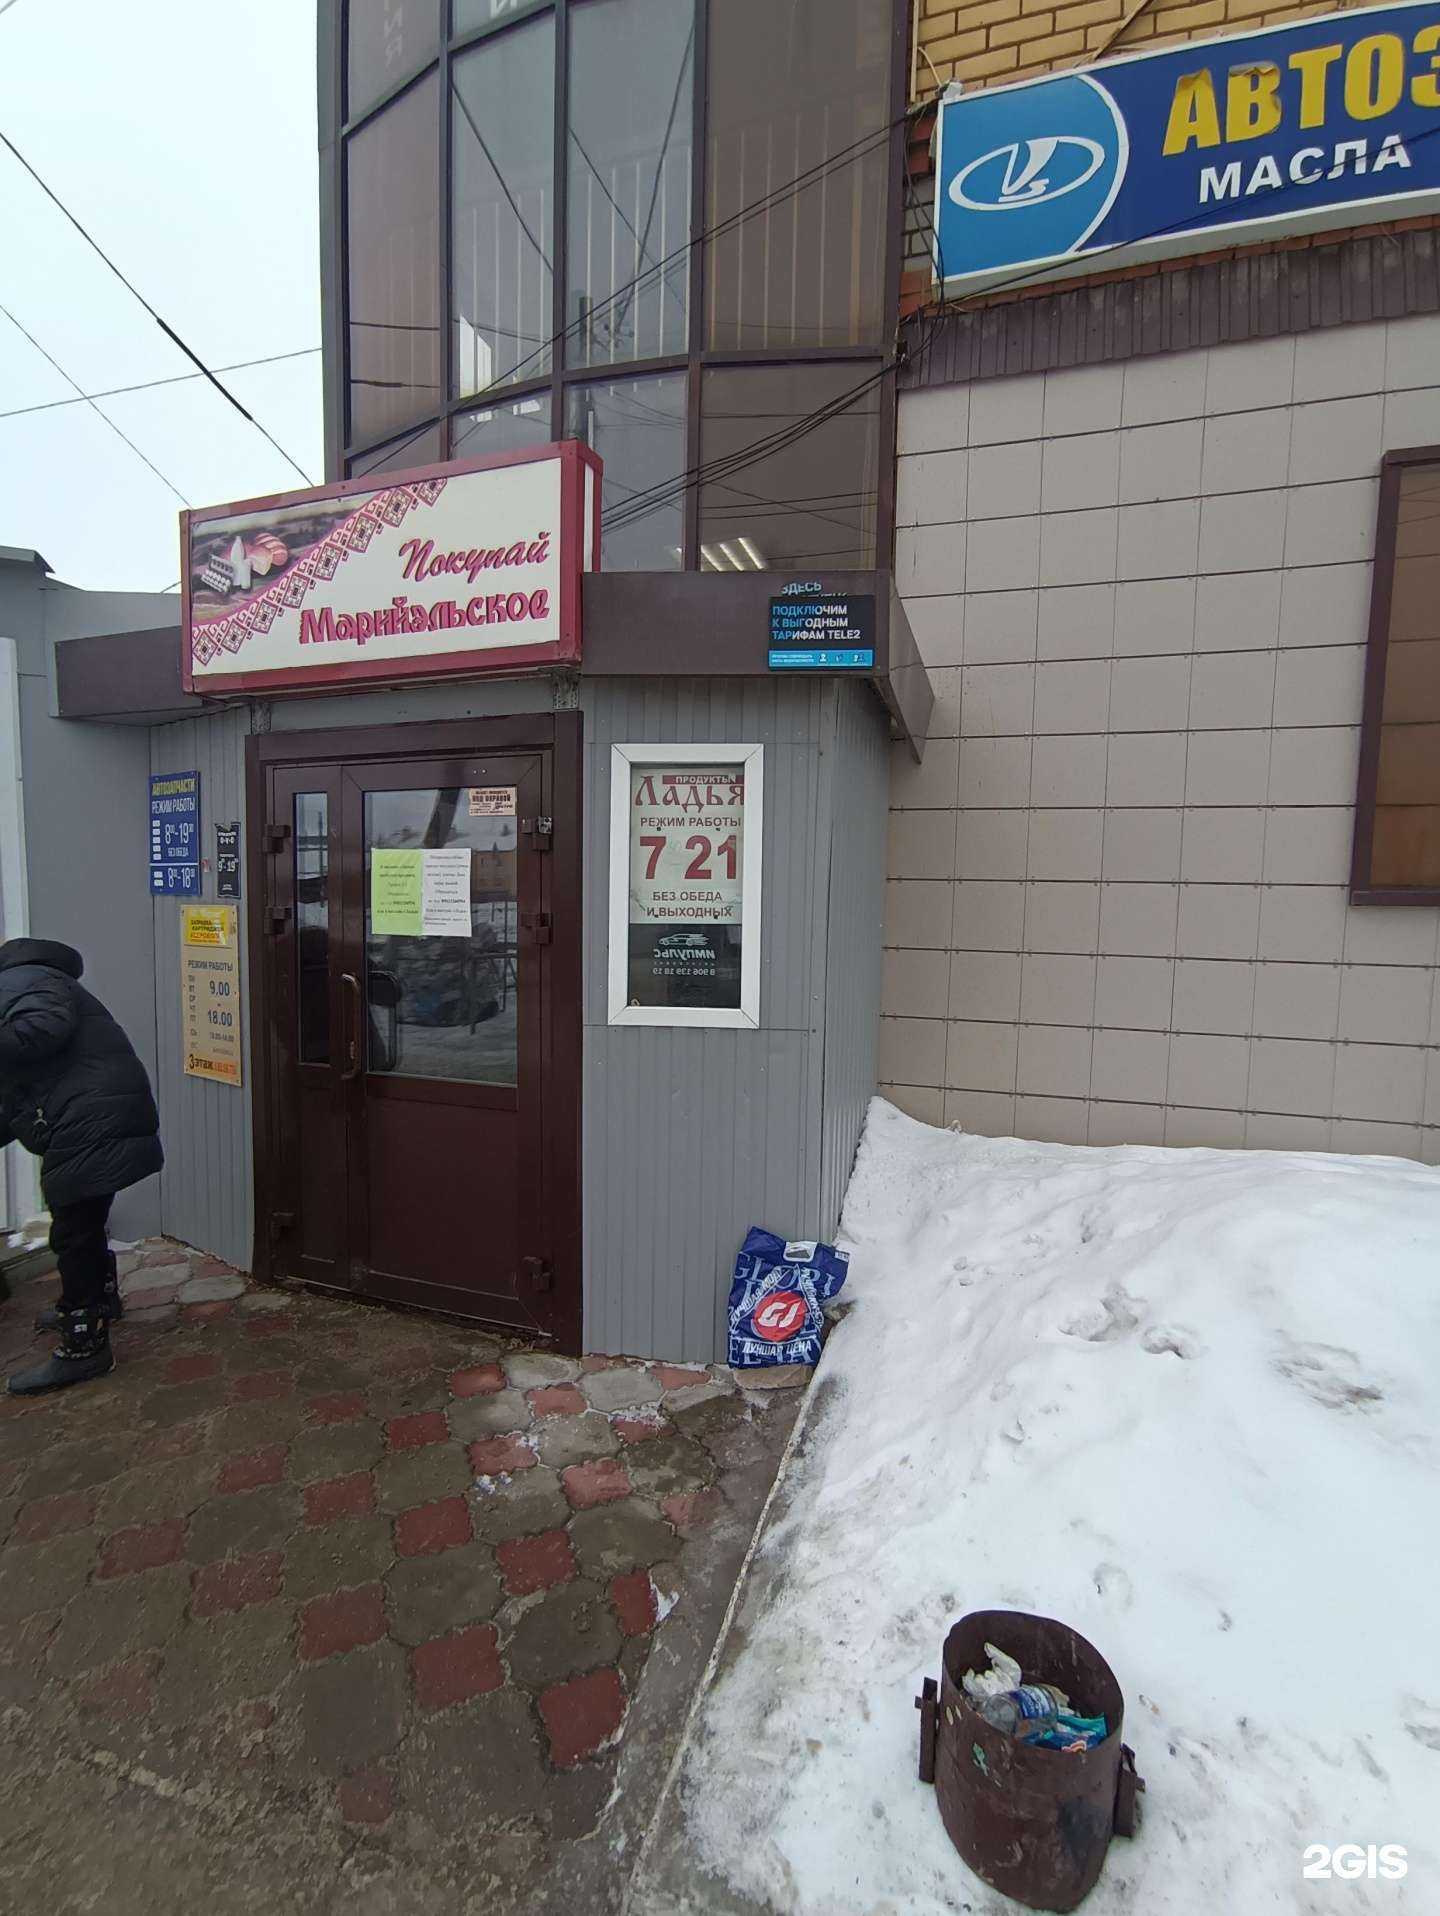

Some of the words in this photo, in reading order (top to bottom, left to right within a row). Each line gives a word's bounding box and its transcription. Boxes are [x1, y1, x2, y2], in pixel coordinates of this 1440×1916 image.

[1199, 135, 1411, 203] МАСЛА
[399, 531, 551, 583] Покупай
[772, 605, 847, 616] ПОДКЛЮЧИМ
[772, 618, 779, 627] К
[782, 618, 848, 628] ВЫГОДНЫМ
[772, 630, 825, 640] ТАРИФАМ
[827, 630, 861, 639] TELE2
[151, 799, 172, 815] РЕЖИМ
[173, 797, 196, 813] РАБОТЫ
[640, 817, 685, 828] РЕЖИМ
[688, 817, 741, 828] РАБОТЫ
[639, 836, 667, 880] 7
[684, 835, 737, 880] 21
[652, 891, 676, 901] БЕЗ
[680, 891, 722, 903] ОБЕДА
[647, 907, 655, 917] И
[659, 907, 732, 918] ВЫХОДНЫХ
[208, 961, 233, 972] РАБОТЫ
